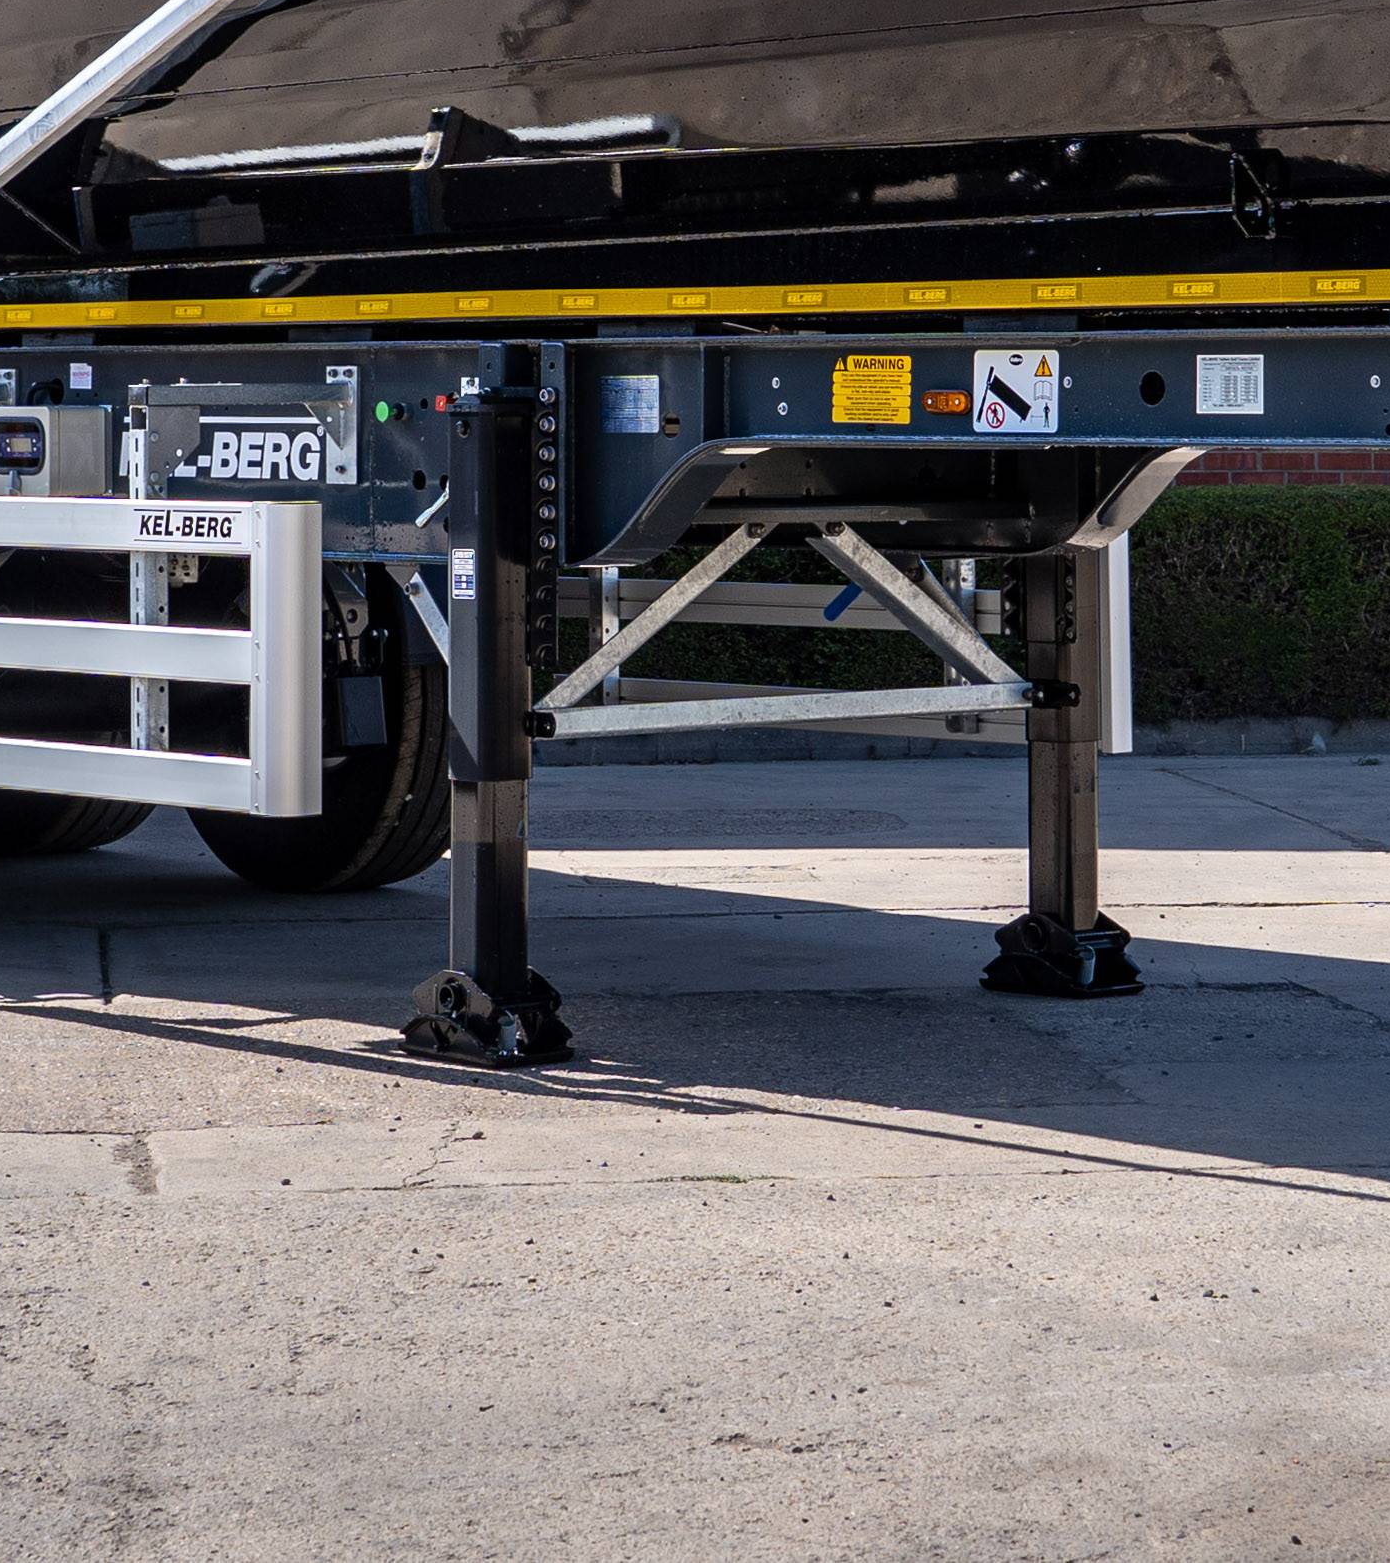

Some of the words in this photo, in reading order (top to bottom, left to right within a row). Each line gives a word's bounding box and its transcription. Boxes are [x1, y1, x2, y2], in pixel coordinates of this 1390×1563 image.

[1316, 279, 1360, 290] KEL-BERG
[853, 358, 904, 370] WARNING
[139, 509, 233, 539] KEL-BERG
